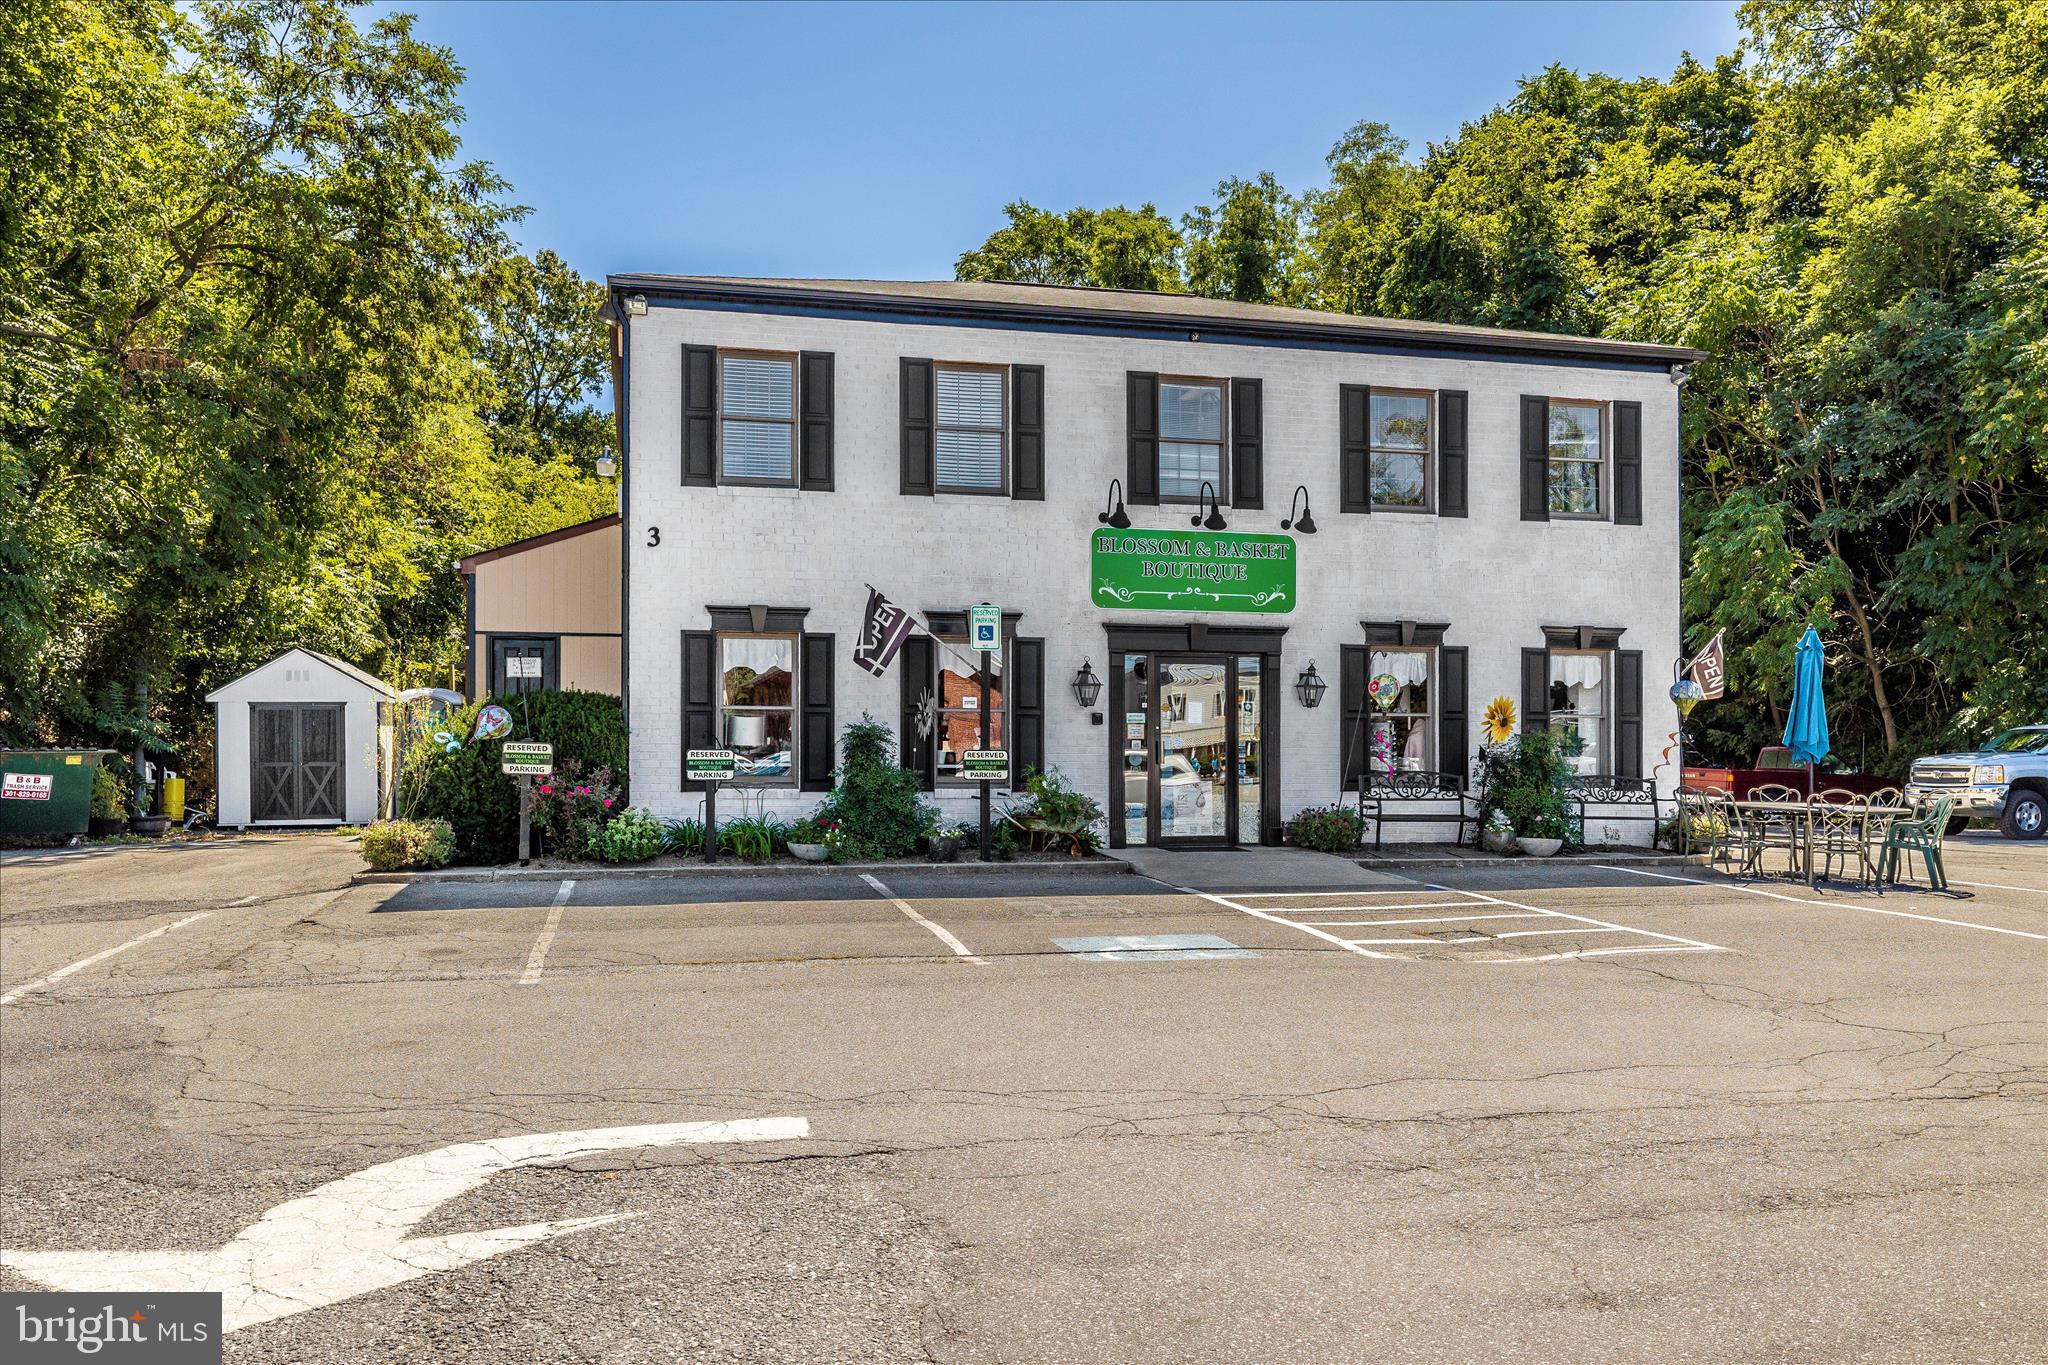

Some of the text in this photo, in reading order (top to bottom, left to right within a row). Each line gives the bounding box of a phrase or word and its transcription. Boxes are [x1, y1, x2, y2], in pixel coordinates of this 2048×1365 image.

[647, 526, 660, 547] 3
[1097, 537, 1290, 560] BLOSSOM & BASKET
[1142, 561, 1248, 583] BOUTIQUE
[506, 744, 548, 752] RESERVED
